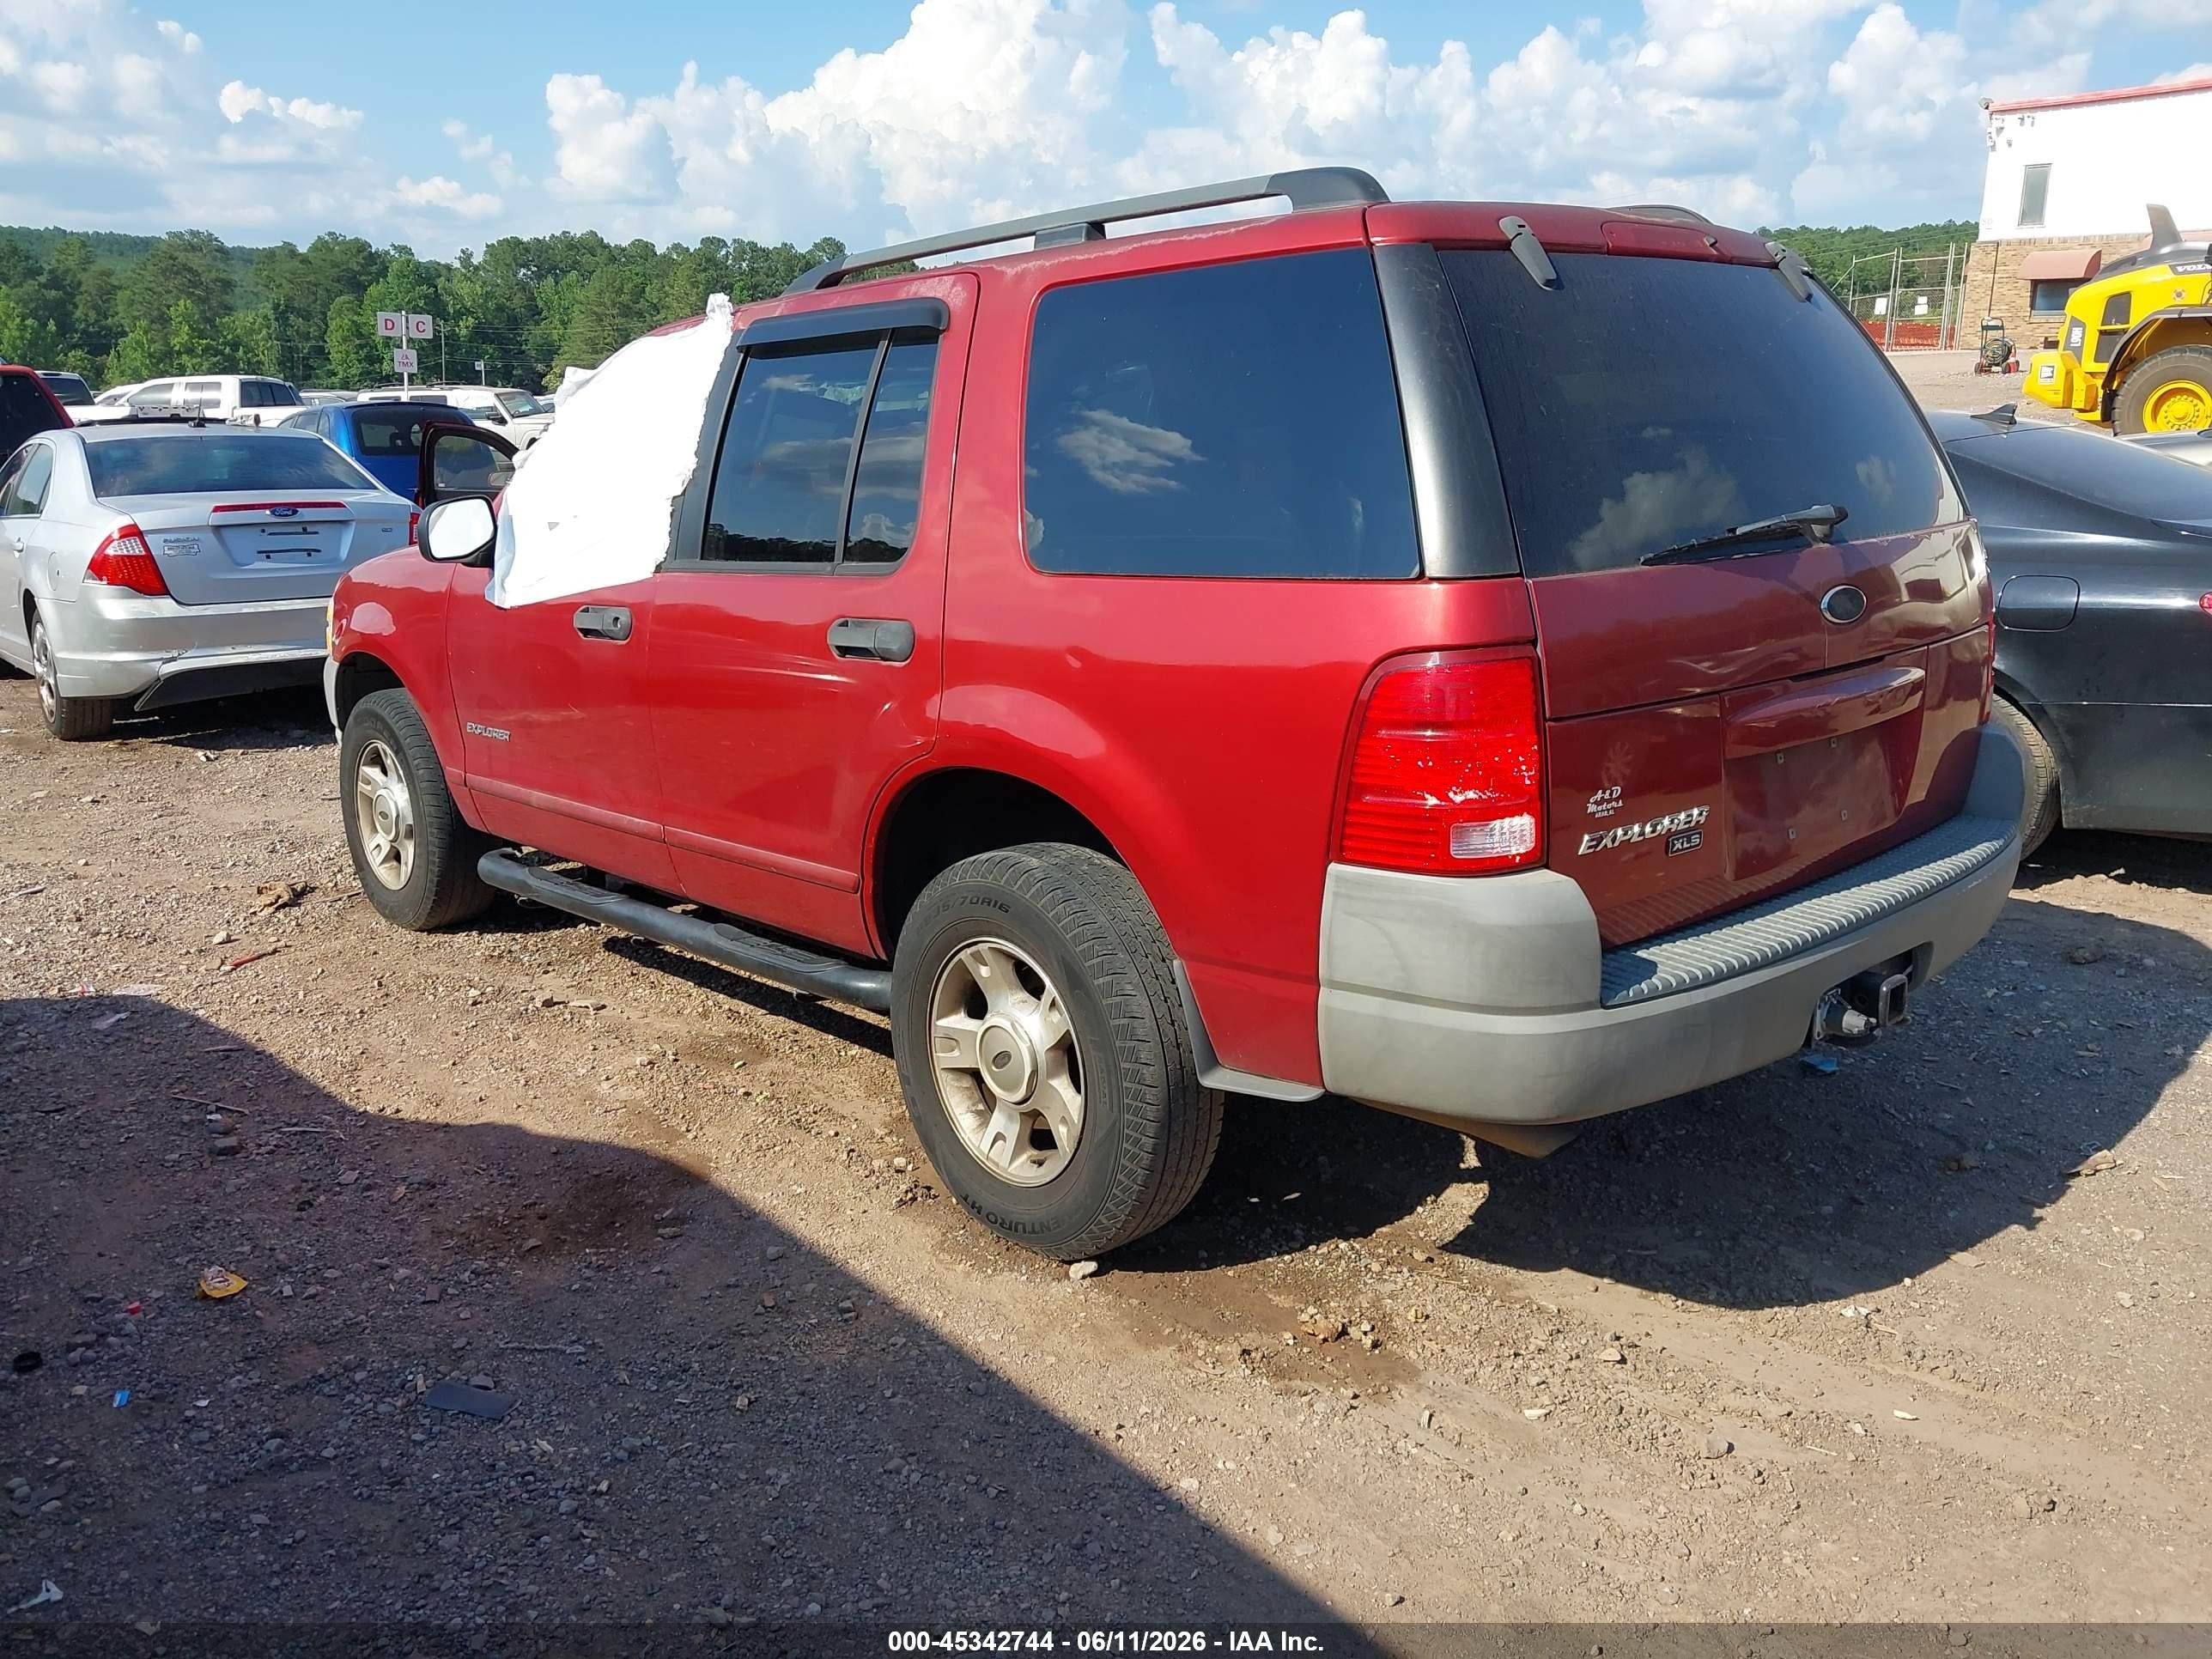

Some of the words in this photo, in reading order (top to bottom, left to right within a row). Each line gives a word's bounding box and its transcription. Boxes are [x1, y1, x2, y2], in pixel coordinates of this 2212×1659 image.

[384, 319, 395, 331] D
[416, 320, 426, 333] C
[466, 721, 511, 742] EXPLORER
[1589, 786, 1621, 803] A&D
[1586, 799, 1624, 814] Motors
[1577, 805, 1711, 856] EXPLORER
[1672, 833, 1701, 852] XLS
